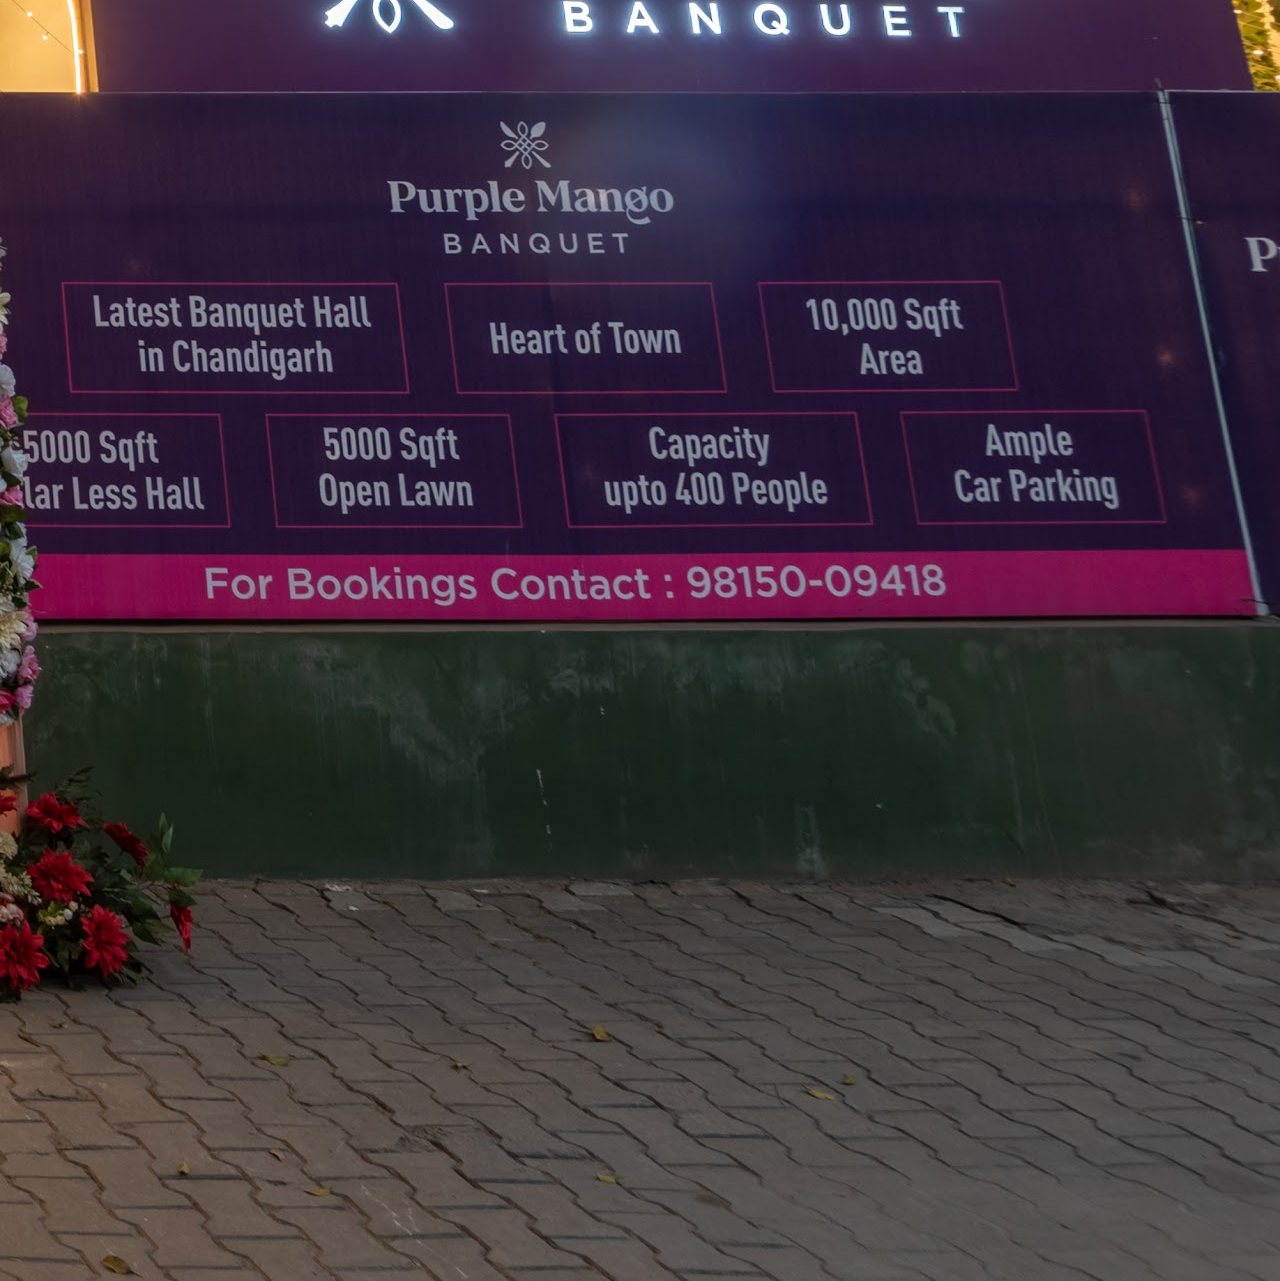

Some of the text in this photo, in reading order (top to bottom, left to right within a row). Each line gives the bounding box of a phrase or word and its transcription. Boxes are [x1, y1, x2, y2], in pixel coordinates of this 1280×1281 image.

[562, 0, 964, 38] BANQUET
[386, 180, 674, 225] Purple Mango
[443, 232, 629, 254] BANQUET
[1244, 237, 1280, 272] P
[93, 294, 372, 336] Latest Banquet Hall
[806, 297, 964, 338] 10,000 Sqft
[489, 321, 682, 355] Heart of Town
[860, 342, 924, 375] Area
[137, 339, 334, 381] in Chandigarh
[22, 429, 160, 472] 5000 Sqft
[323, 426, 460, 469] 5000 Sqft
[648, 426, 770, 467] Capacity
[985, 423, 1074, 464] Ample
[22, 475, 205, 510] lar Less Hall
[319, 472, 474, 515] Open Lawn
[604, 471, 828, 515] upto 400 People
[954, 468, 1119, 510] Car Parking
[205, 564, 946, 607] For Bookings Contact : 98150-09418
